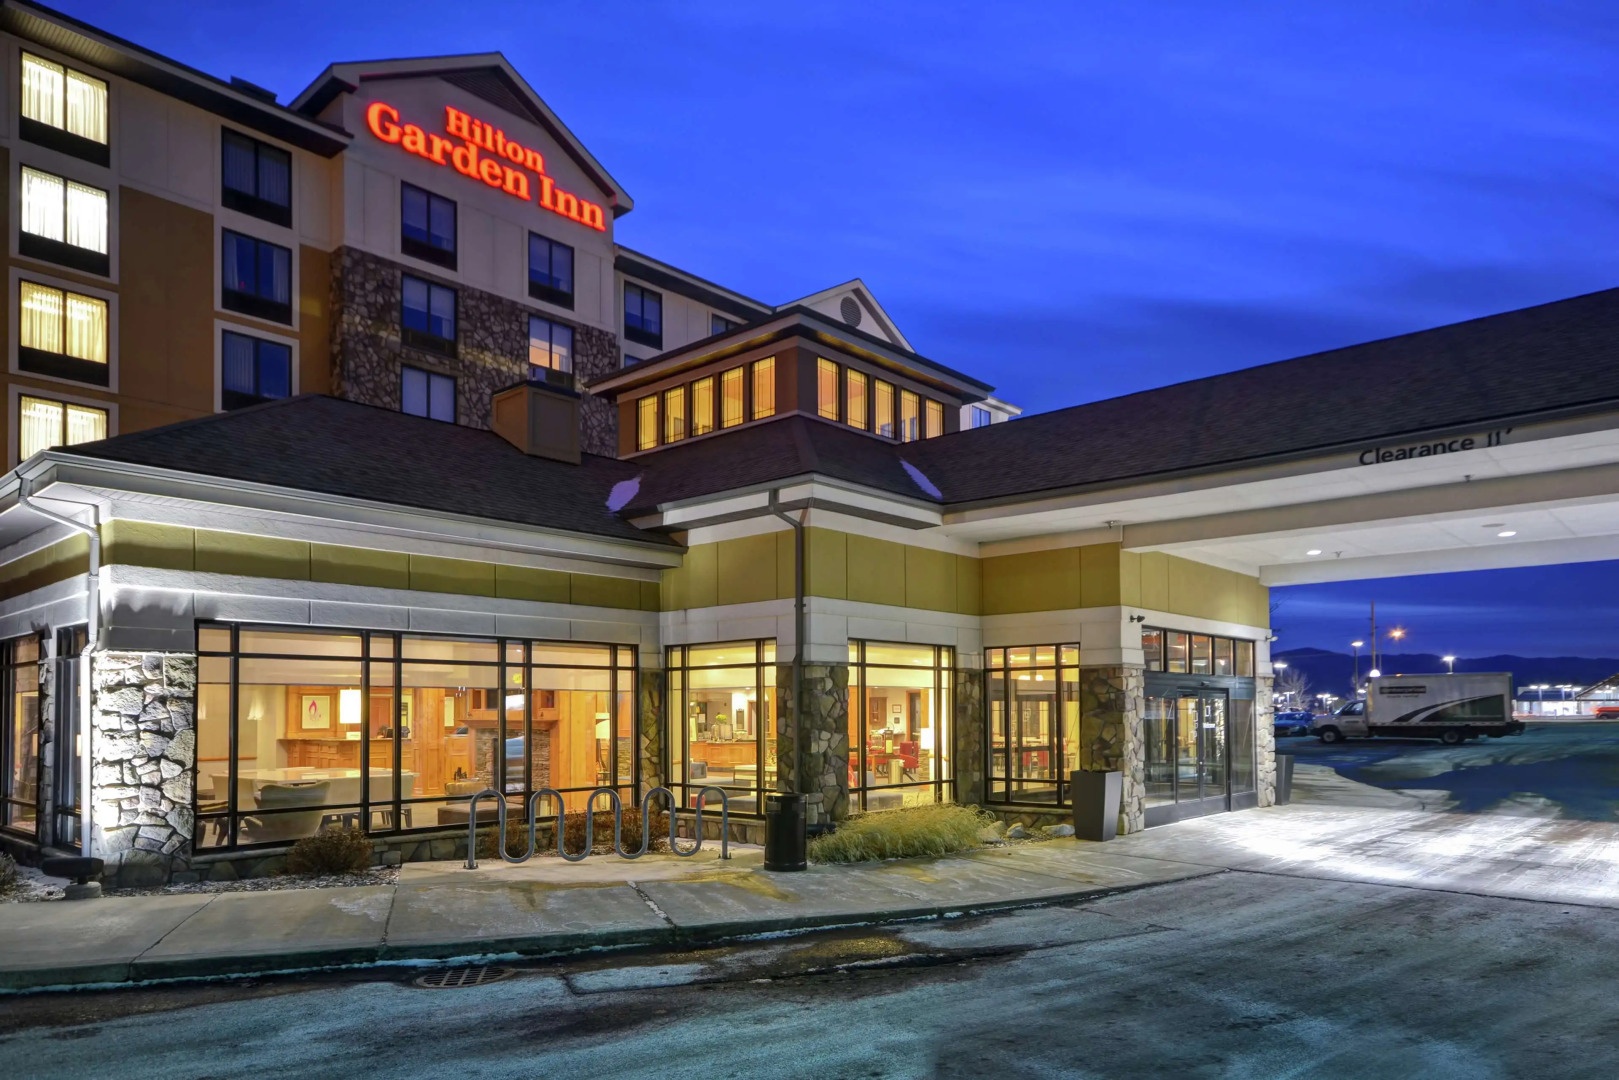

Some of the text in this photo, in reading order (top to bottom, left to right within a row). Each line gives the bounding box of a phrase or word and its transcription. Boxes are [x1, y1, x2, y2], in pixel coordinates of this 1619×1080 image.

[367, 101, 606, 231] Garden Inn
[445, 105, 544, 174] Hilton
[1360, 438, 1474, 465] Clearance
